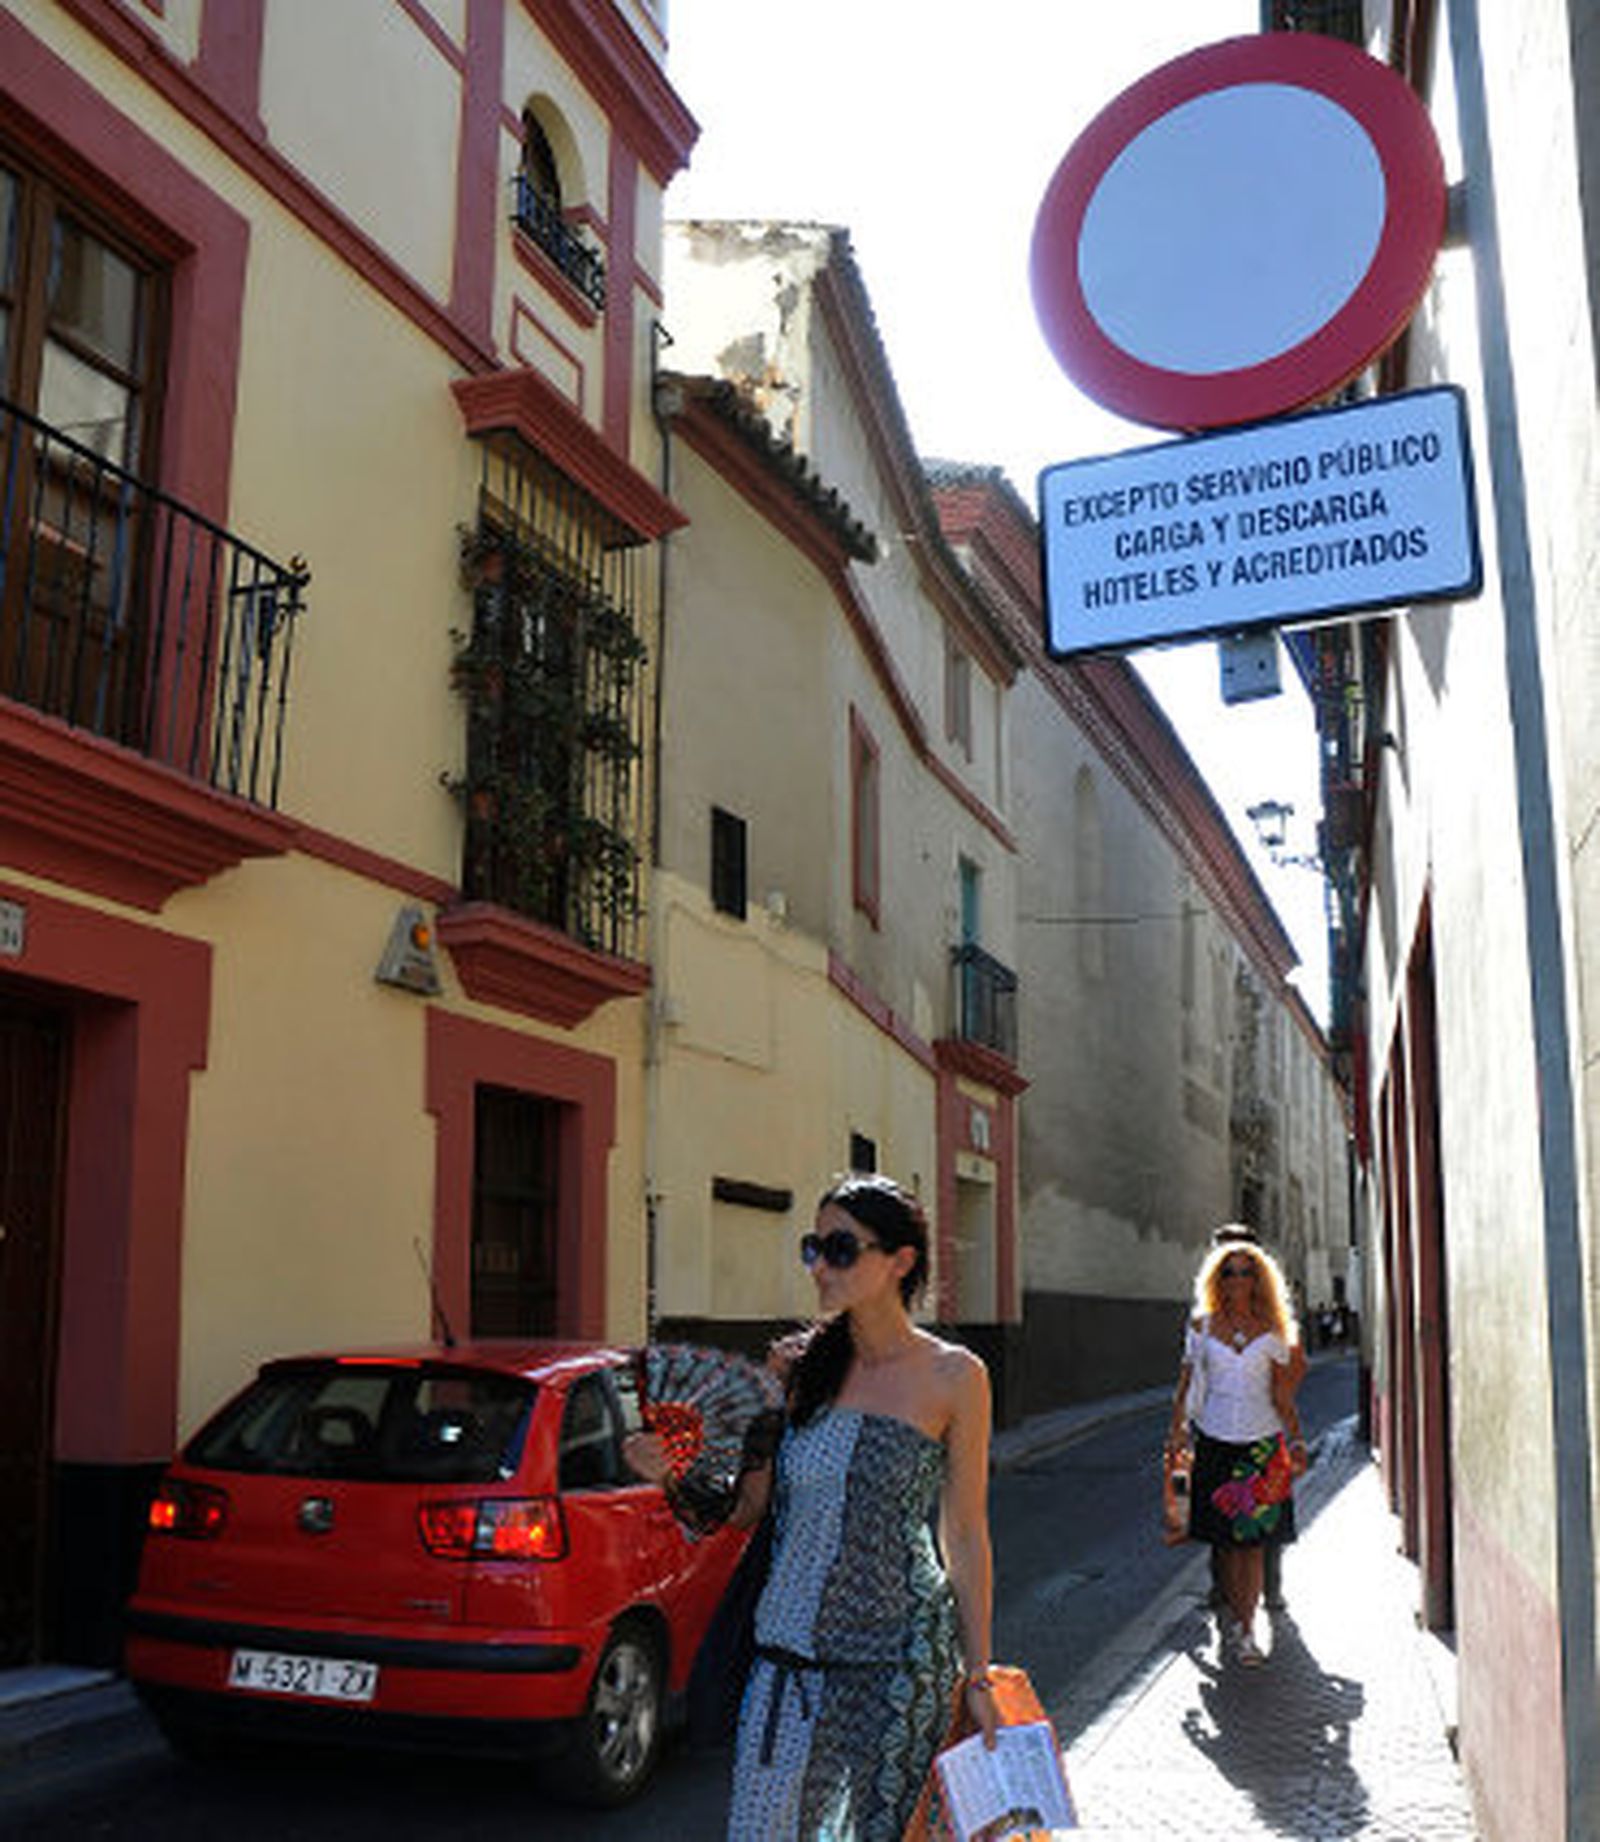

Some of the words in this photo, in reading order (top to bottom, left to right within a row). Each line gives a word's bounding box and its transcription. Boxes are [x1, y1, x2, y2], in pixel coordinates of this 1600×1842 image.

[1064, 481, 1178, 527] EXCEPTO
[1186, 456, 1312, 505] SERVICIO
[1318, 432, 1440, 480] PÚBLICO
[1115, 519, 1204, 560] CARGA
[1210, 513, 1230, 545] Y
[1238, 488, 1387, 540] DESCARGA
[1083, 564, 1198, 609] HOTELES
[1206, 555, 1225, 588] Y
[1232, 527, 1428, 583] ACREDITADOS
